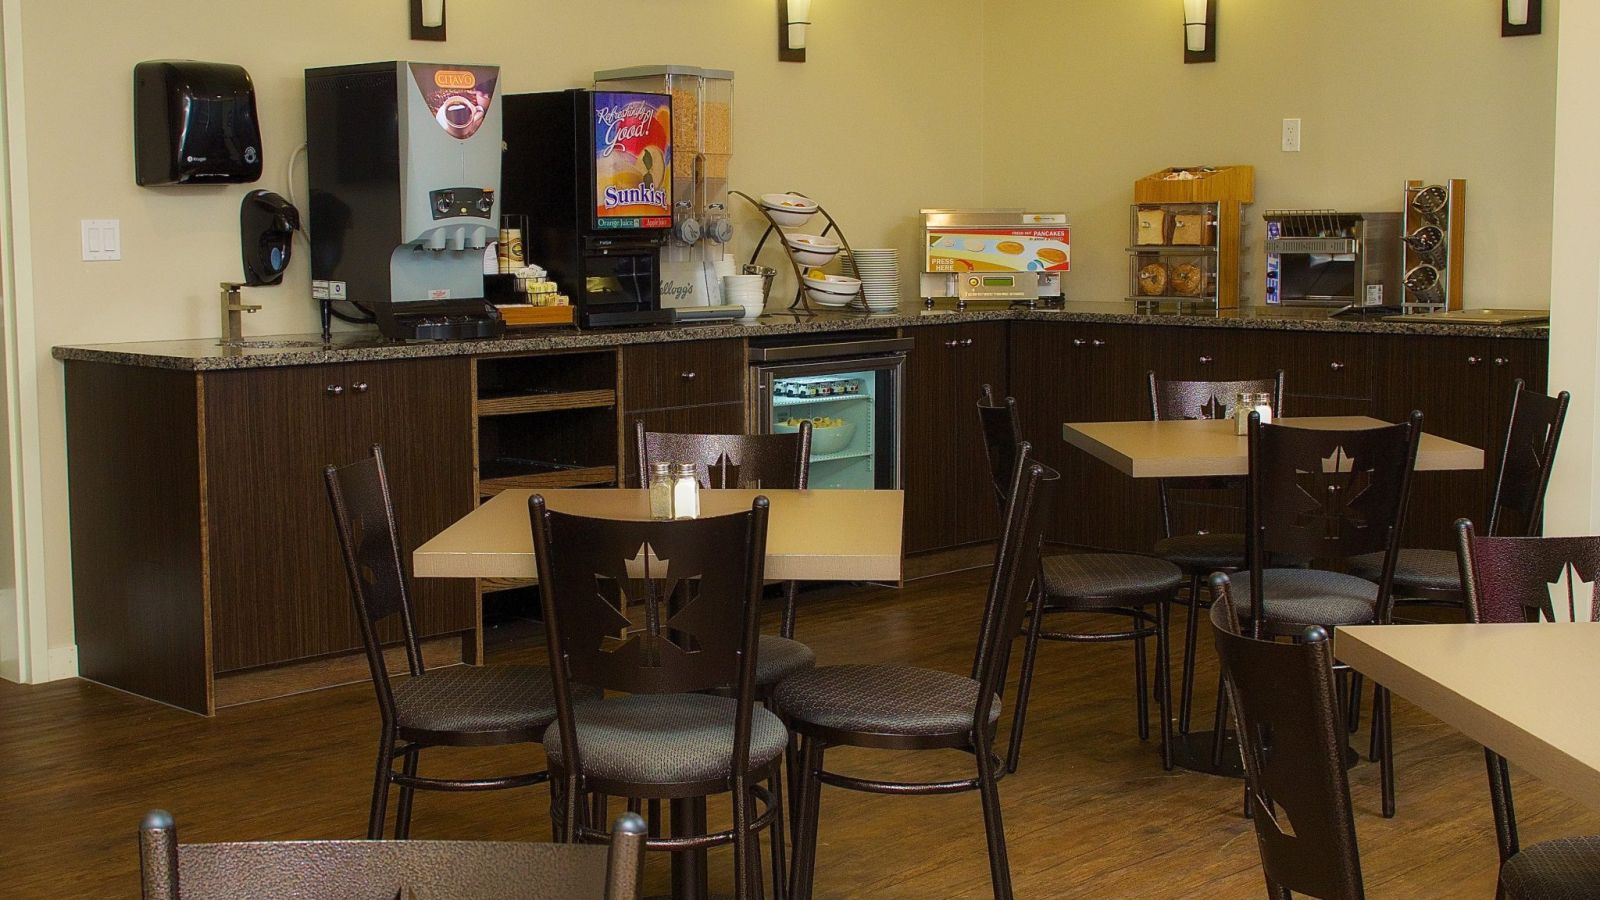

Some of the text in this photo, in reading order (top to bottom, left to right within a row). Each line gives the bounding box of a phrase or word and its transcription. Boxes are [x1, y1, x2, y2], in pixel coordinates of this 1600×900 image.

[437, 73, 472, 85] CITAVO
[603, 109, 654, 157] Good!
[604, 182, 668, 211] Sunkist
[598, 218, 620, 229] Orange
[660, 280, 694, 300] ellogg's
